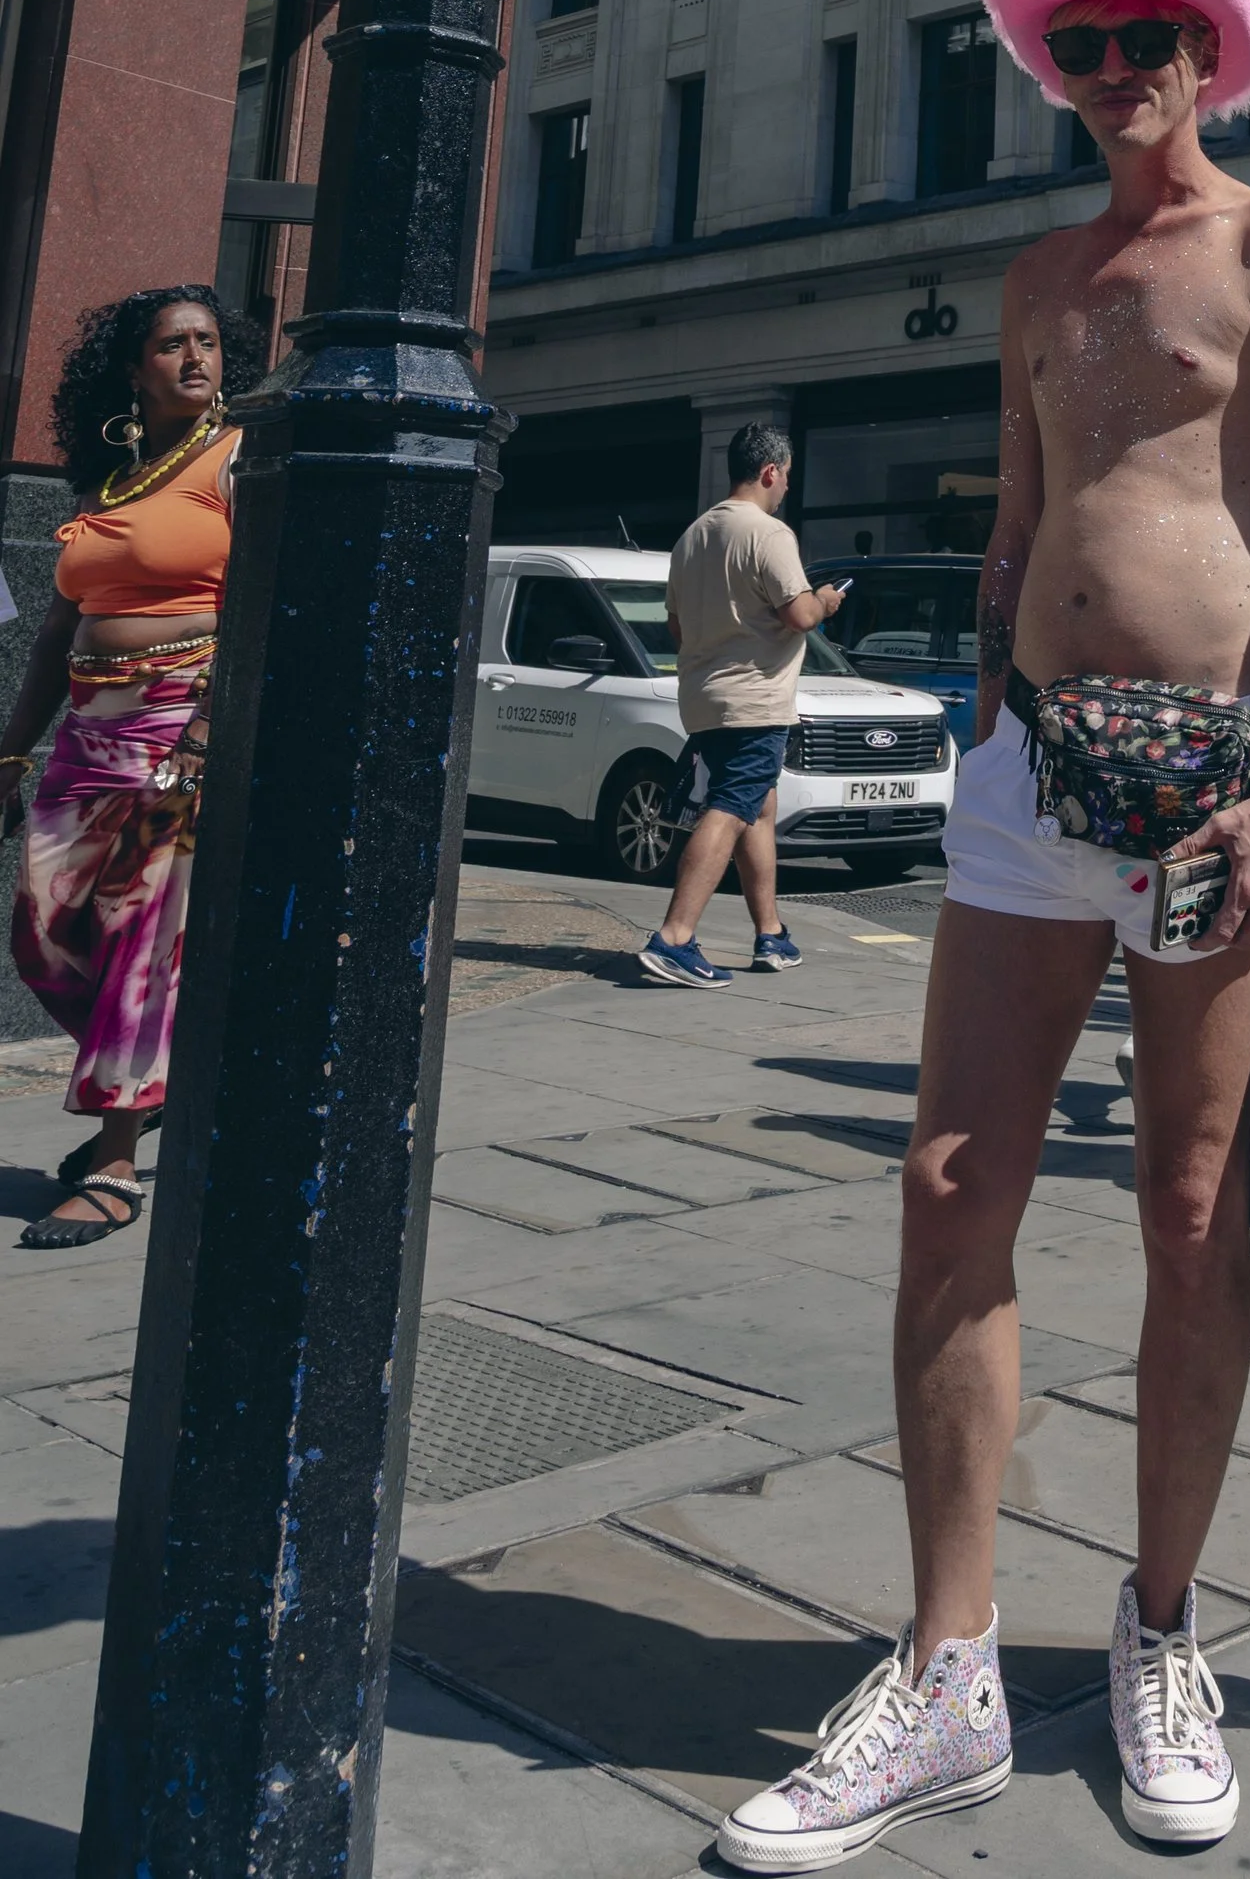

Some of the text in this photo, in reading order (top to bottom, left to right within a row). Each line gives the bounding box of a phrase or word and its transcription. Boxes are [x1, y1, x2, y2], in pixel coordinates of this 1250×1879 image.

[904, 287, 957, 340] alo
[507, 706, 537, 722] 01322
[539, 709, 577, 727] 559918
[871, 732, 892, 745] Ford
[851, 782, 915, 800] FY24 ZNU
